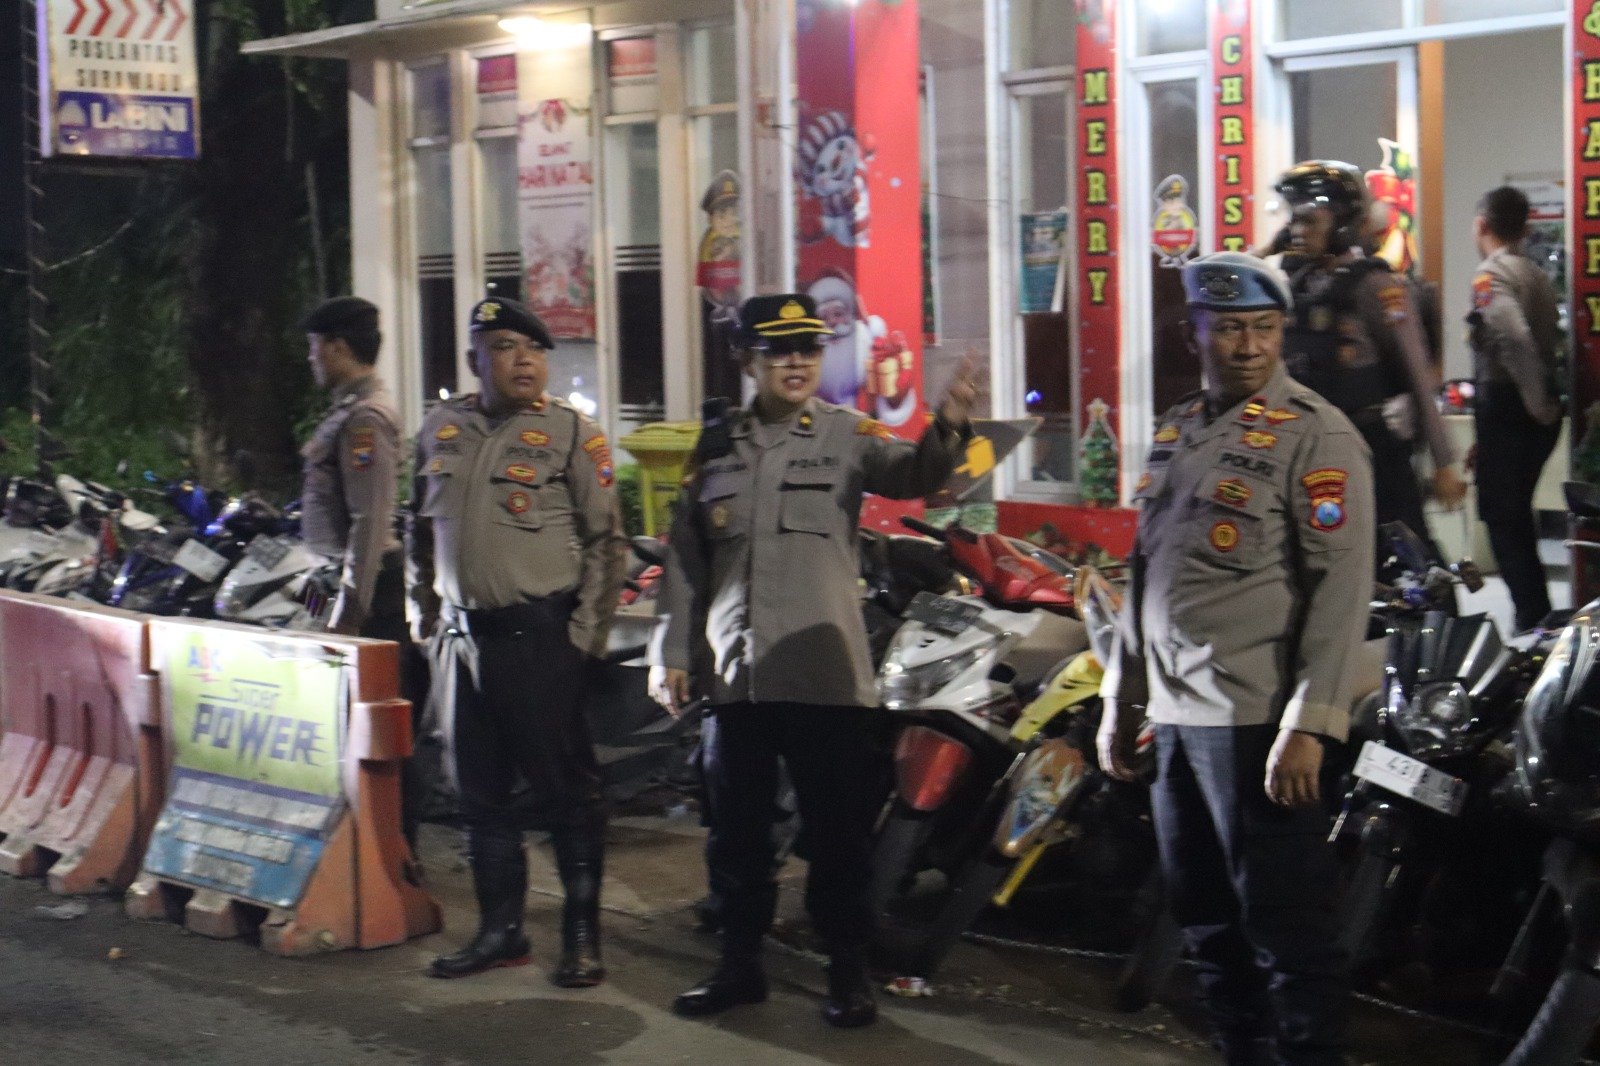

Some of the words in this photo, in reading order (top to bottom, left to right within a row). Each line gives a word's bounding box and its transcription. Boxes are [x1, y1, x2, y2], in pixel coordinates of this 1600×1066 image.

[1083, 69, 1110, 305] MERRY
[1218, 451, 1278, 478] POLRI
[190, 701, 325, 768] POWER
